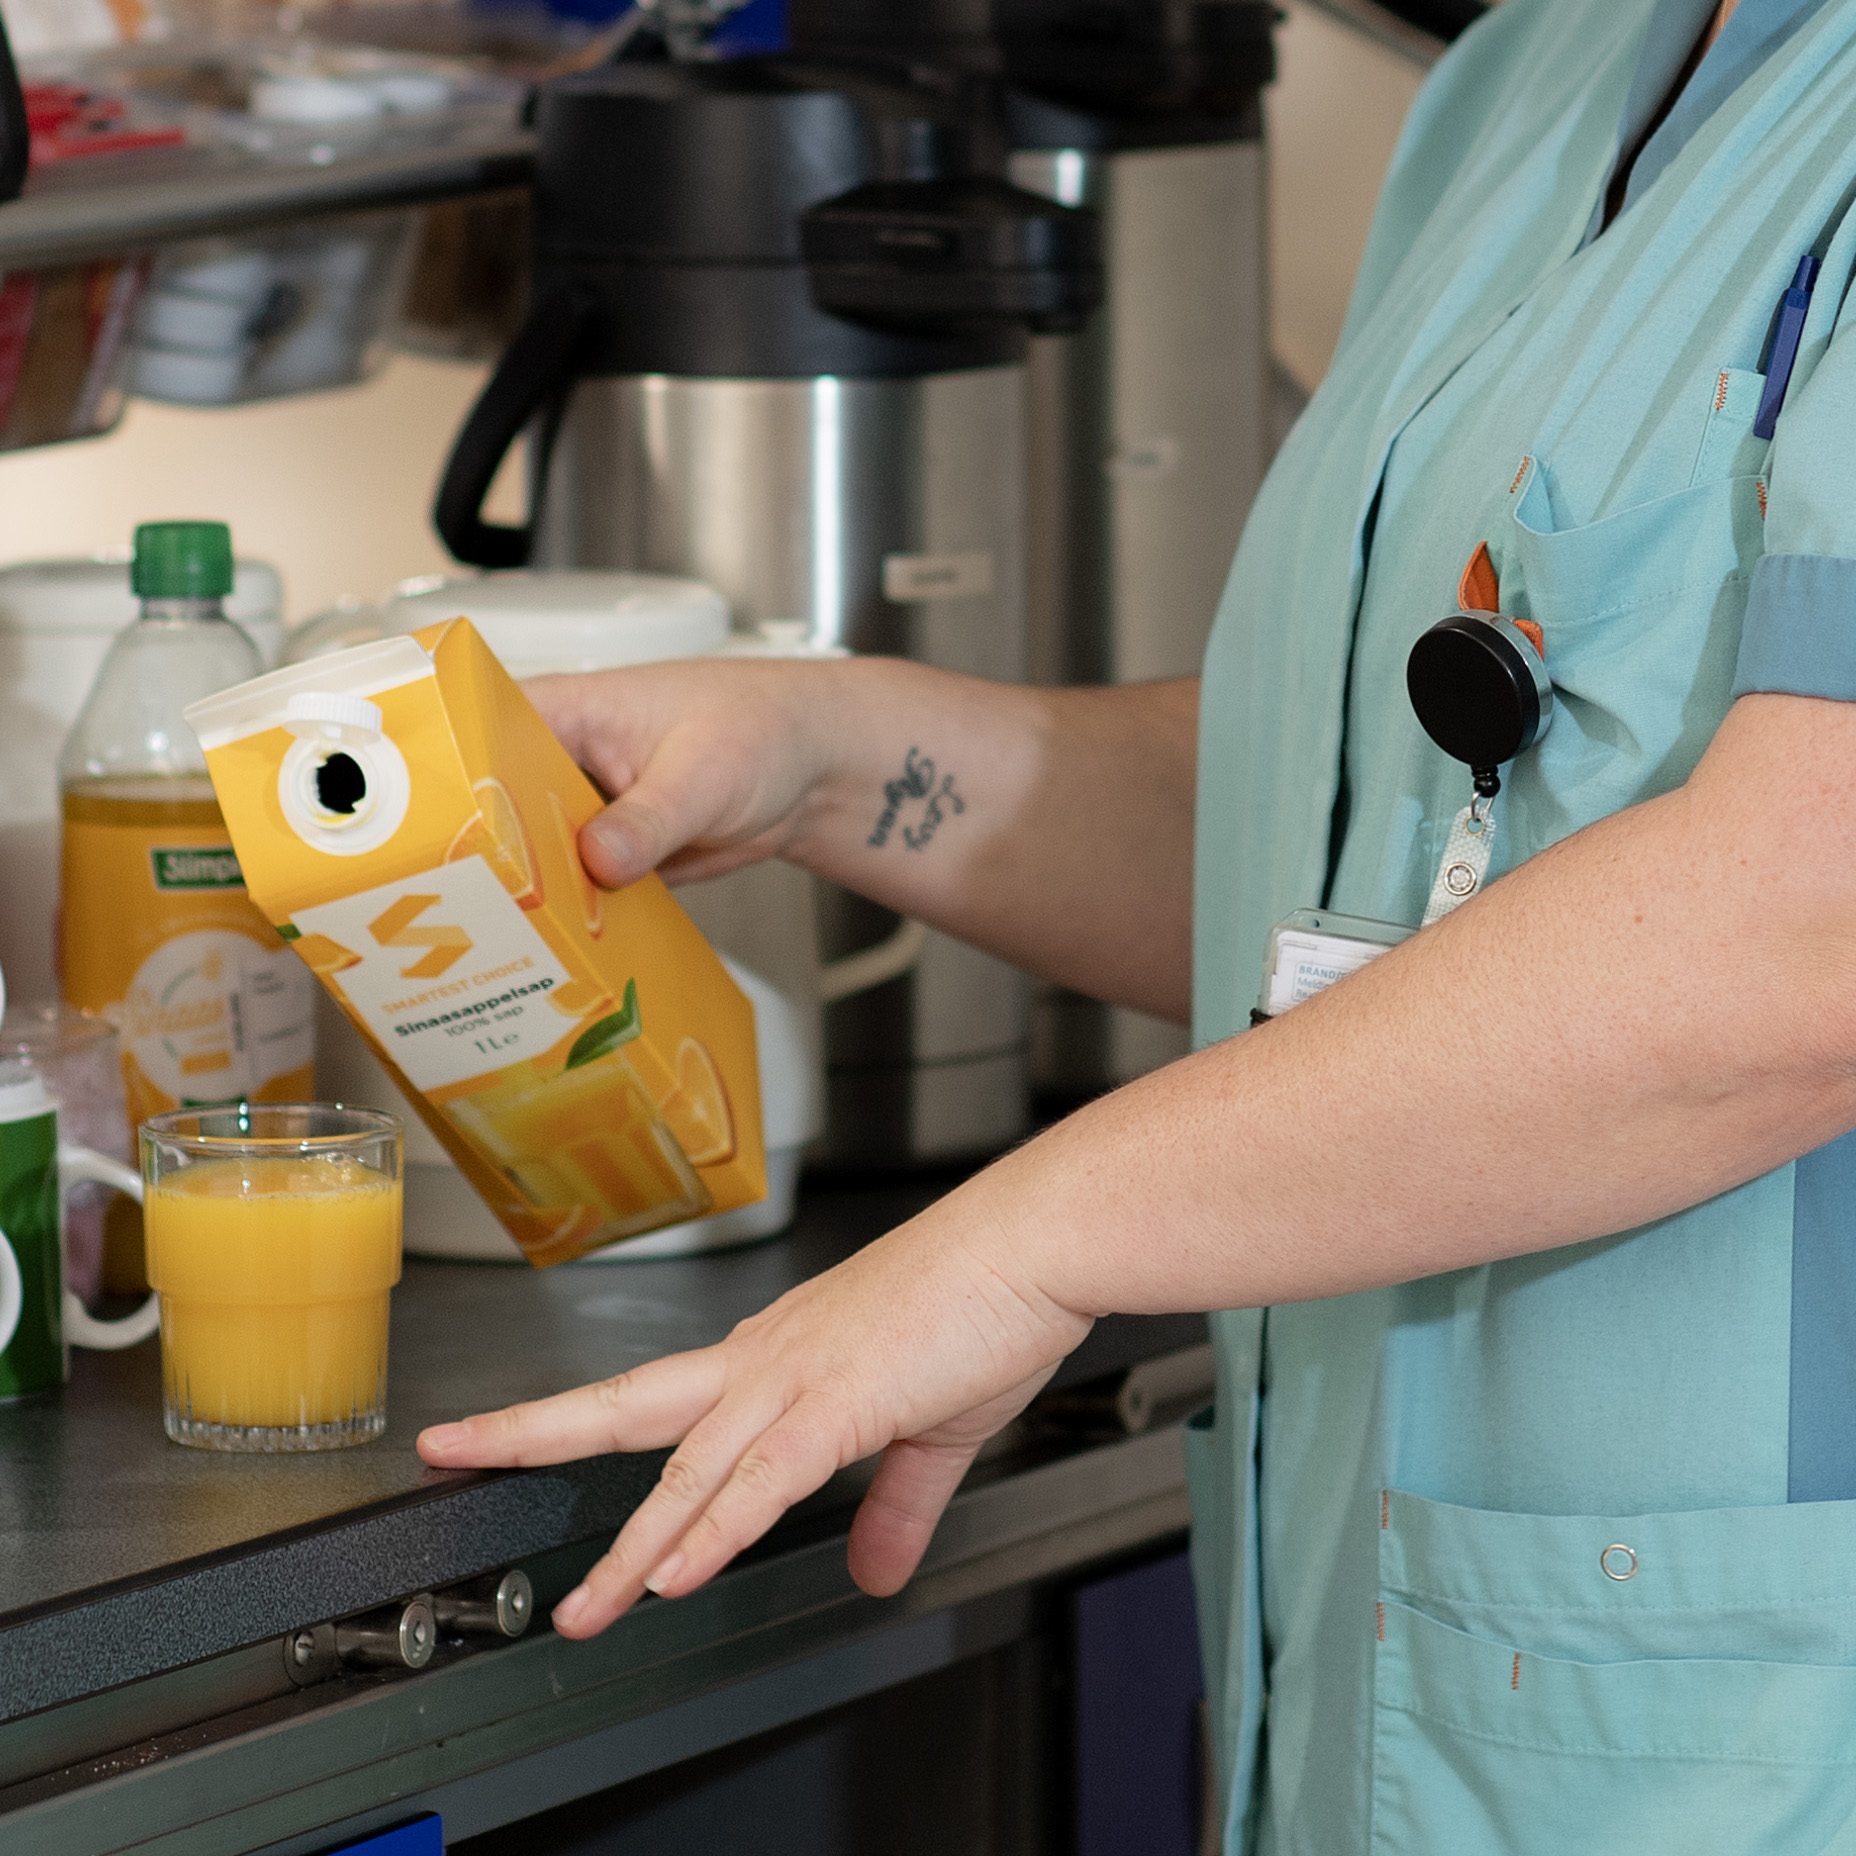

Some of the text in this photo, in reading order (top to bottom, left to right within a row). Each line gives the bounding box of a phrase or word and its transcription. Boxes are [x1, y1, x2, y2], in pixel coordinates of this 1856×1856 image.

[381, 955, 536, 1016] SMARTEST CHOICE
[394, 977, 554, 1037] Sinaasappelsap
[444, 1005, 524, 1038] 100% sap
